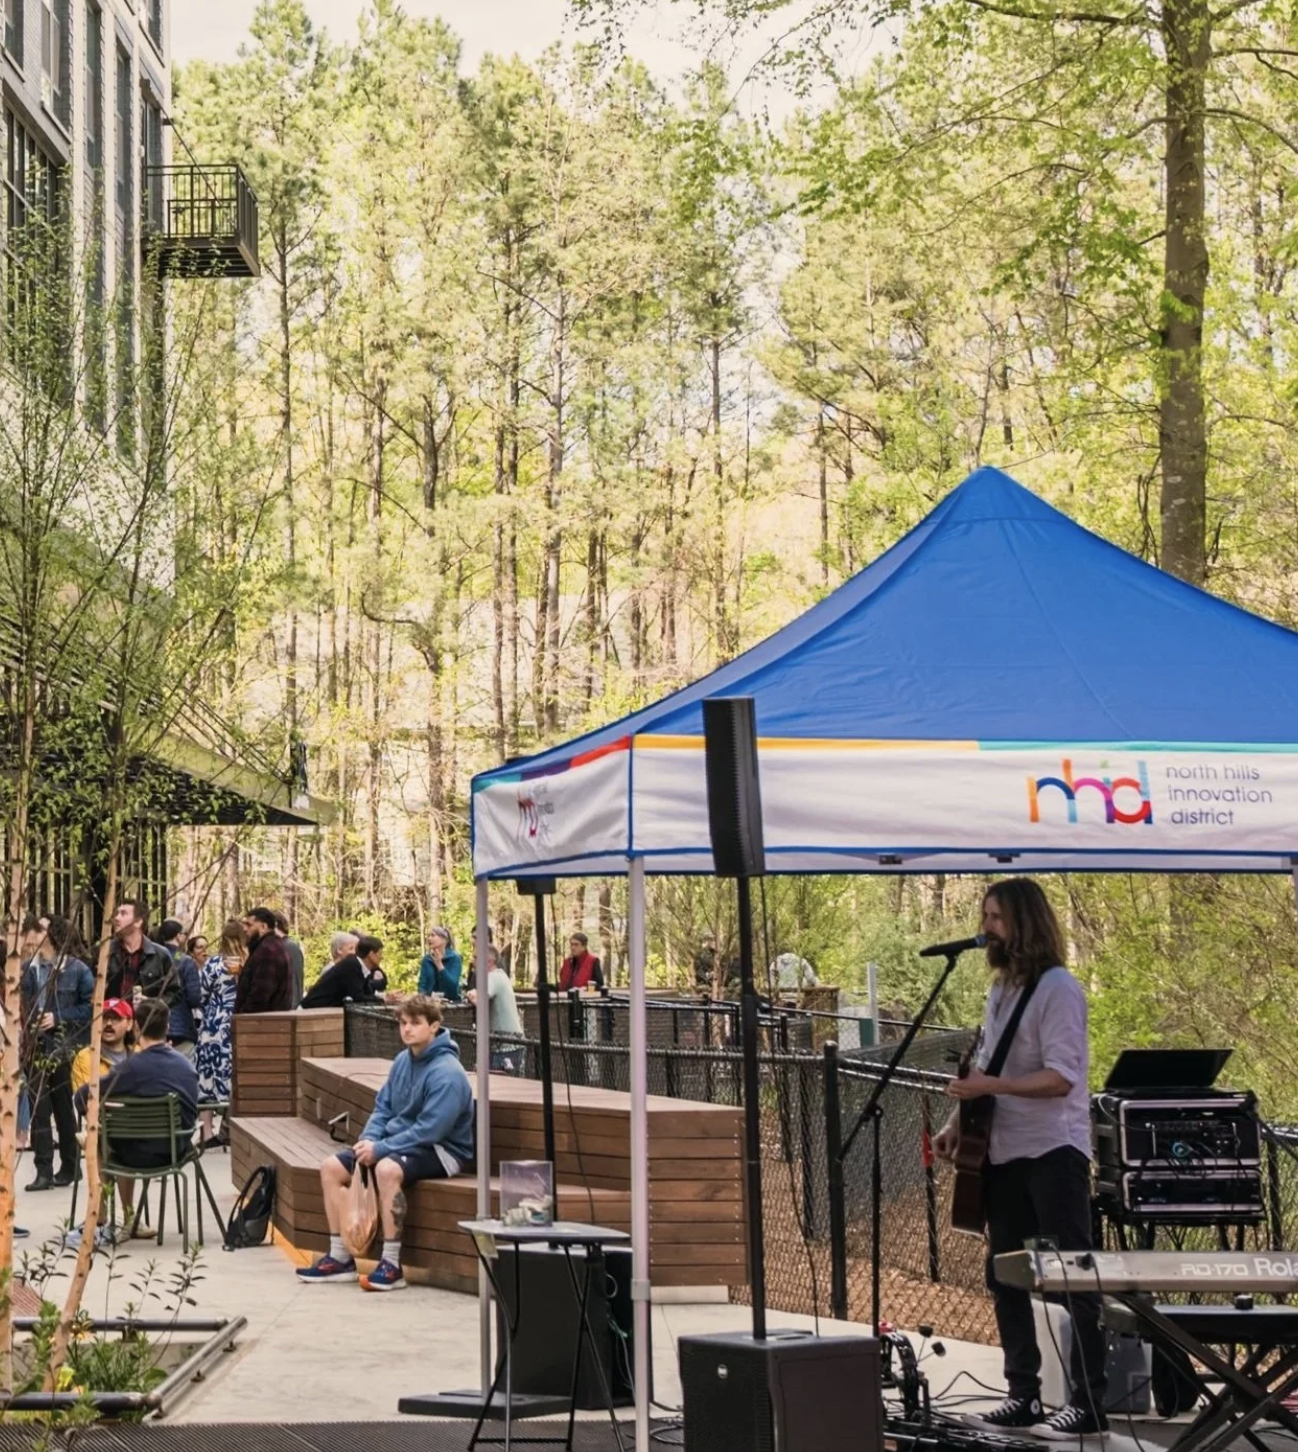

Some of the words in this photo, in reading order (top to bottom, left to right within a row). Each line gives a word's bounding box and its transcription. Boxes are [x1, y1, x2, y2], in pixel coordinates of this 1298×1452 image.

[1165, 764, 1218, 780] north
[1223, 764, 1261, 781] hills
[1168, 785, 1274, 803] innovation
[1171, 808, 1235, 826] district
